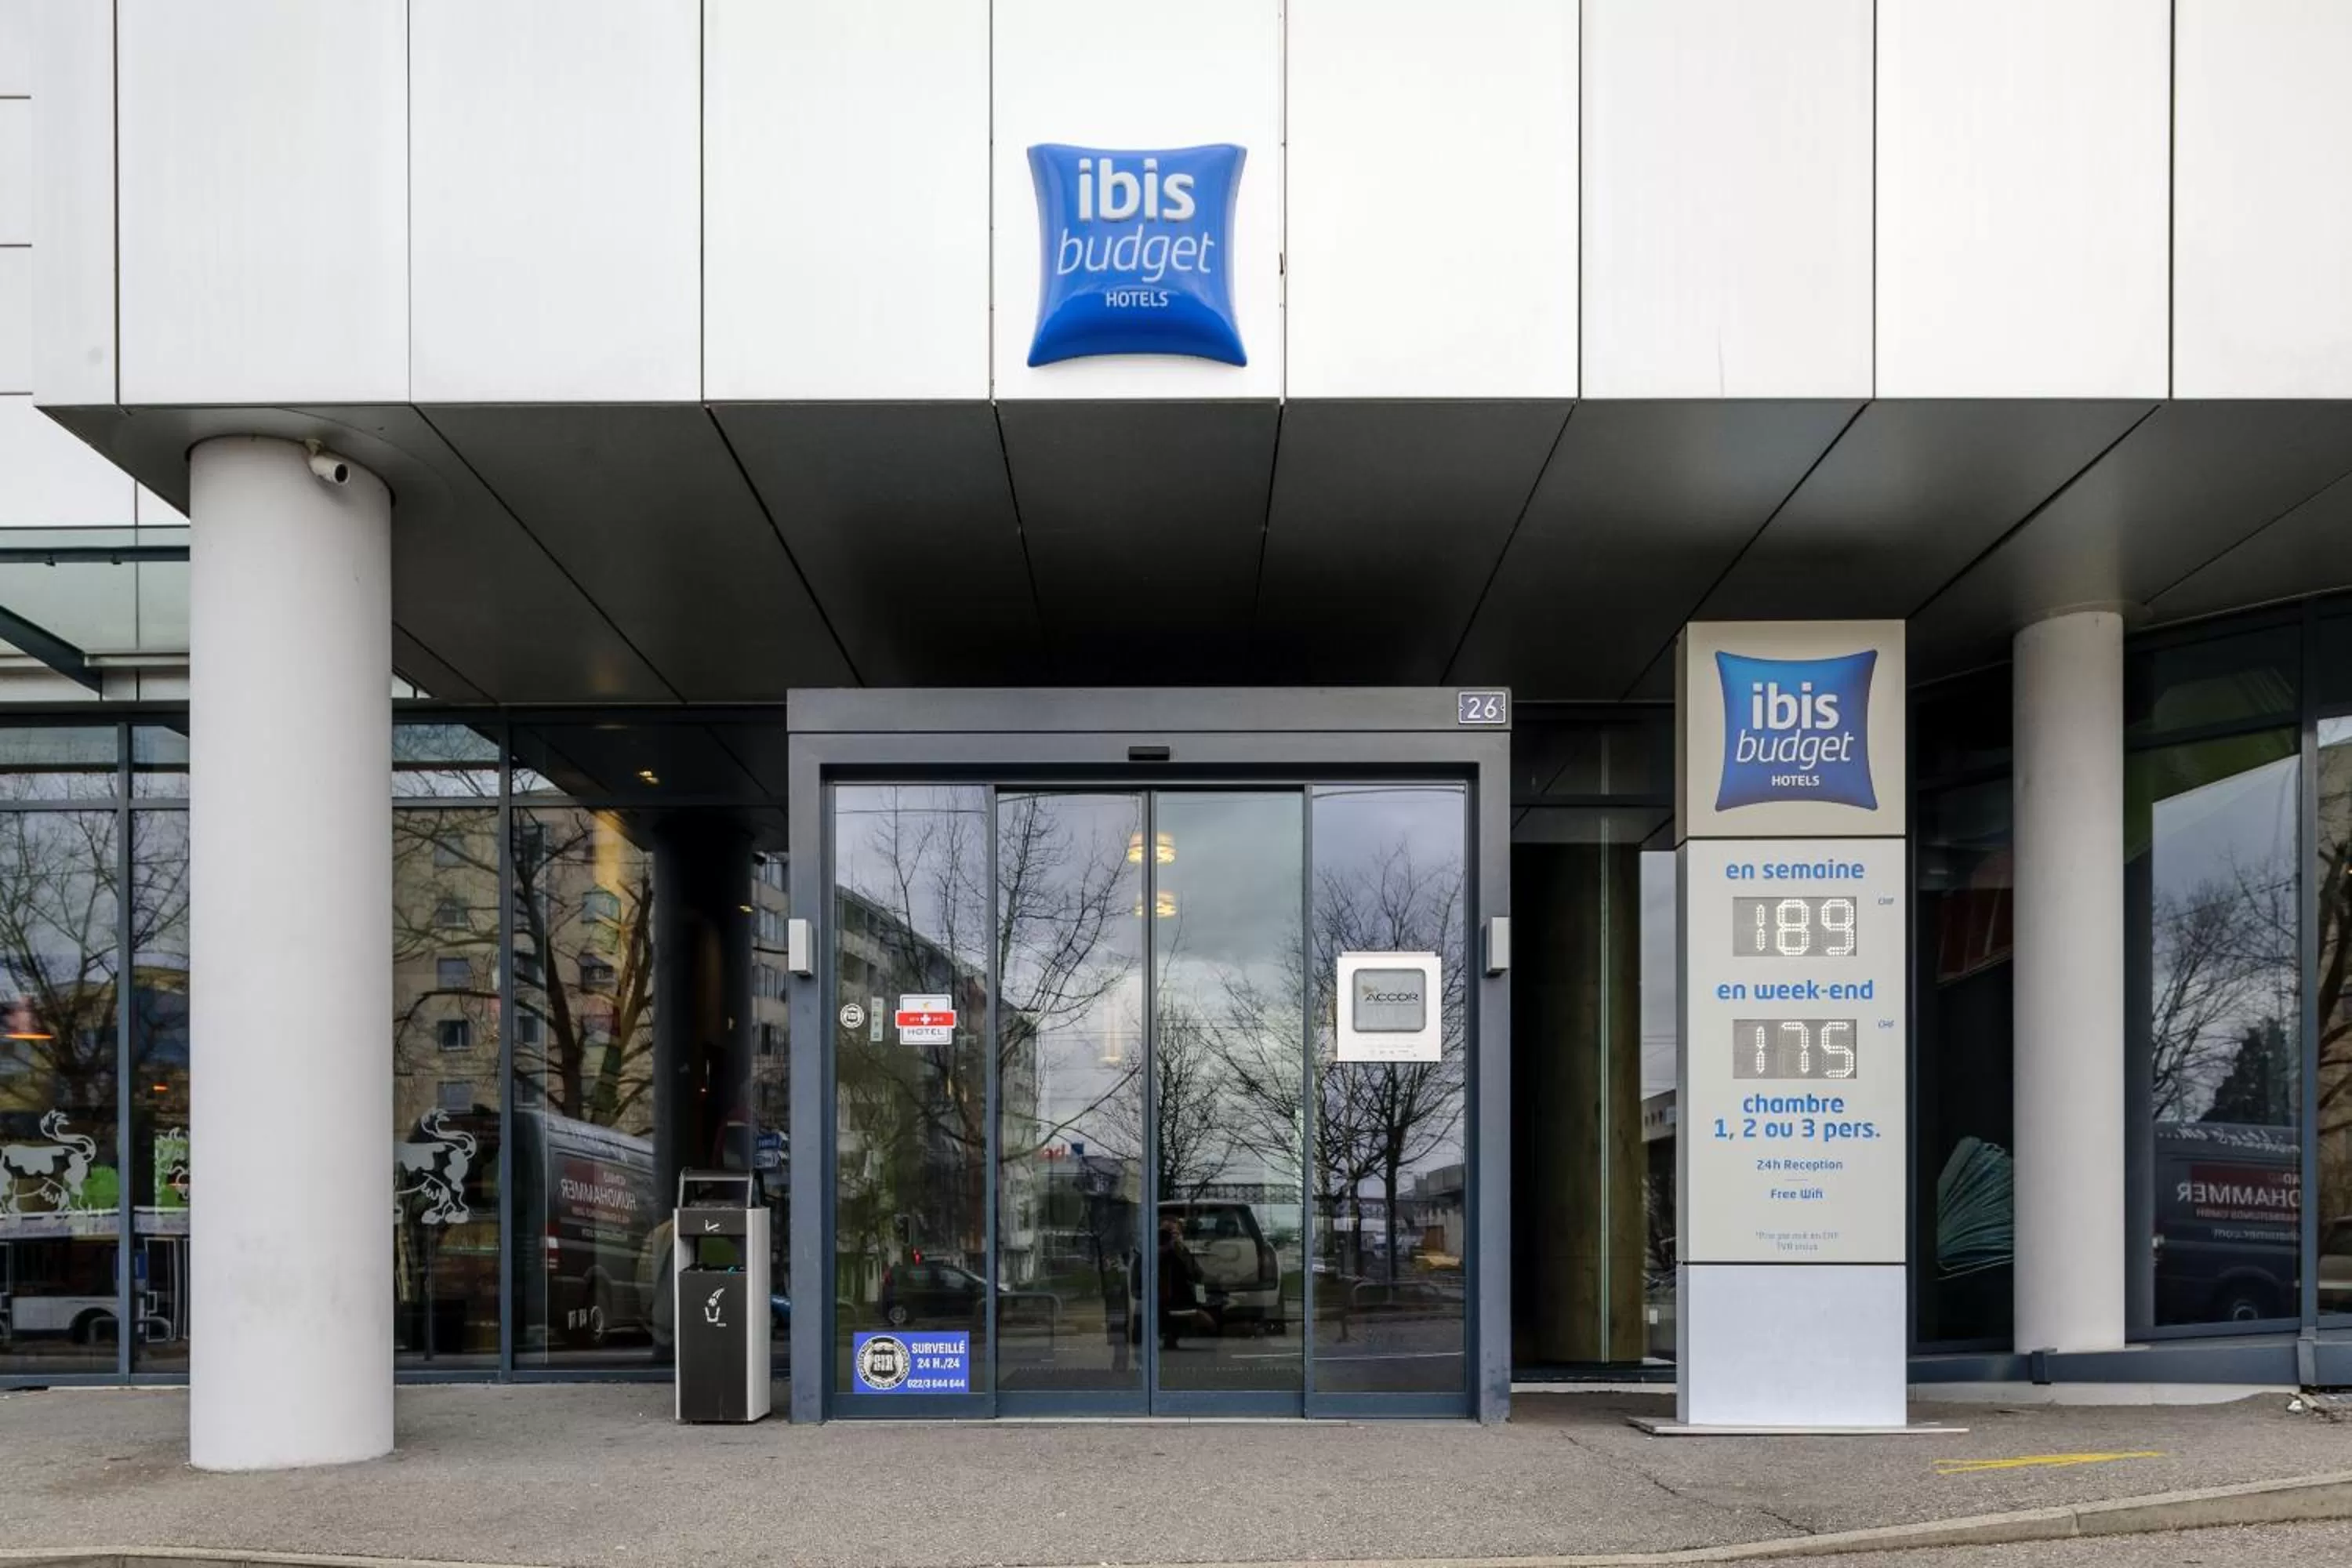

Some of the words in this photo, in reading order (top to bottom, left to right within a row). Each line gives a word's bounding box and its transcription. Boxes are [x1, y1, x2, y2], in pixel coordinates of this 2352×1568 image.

[1078, 158, 1196, 222] ibis
[1056, 223, 1214, 282] budget
[1106, 291, 1169, 307] HOTELS
[1467, 697, 1497, 719] 26
[1752, 682, 1840, 730] ibis
[1736, 729, 1854, 770] budget
[1771, 775, 1820, 786] HOTELS
[1726, 863, 1755, 880] en
[1762, 859, 1865, 880] semaine
[1755, 898, 1855, 956] 189
[1365, 993, 1418, 1002] ACCOR
[1717, 983, 1746, 1000] en
[1754, 980, 1874, 1000] week-end
[1755, 1021, 1855, 1078] 175
[1742, 1094, 1845, 1113] chambre
[1714, 1119, 1734, 1140] 1,
[1743, 1119, 1757, 1138] 2
[1764, 1123, 1794, 1138] ou
[1801, 1119, 1815, 1138] 3
[1824, 1123, 1881, 1142] pers.
[1756, 1160, 1780, 1171] 24h
[1784, 1160, 1843, 1172] Reception
[1769, 1189, 1797, 1200] Free
[1800, 1189, 1824, 1200] Wifi
[912, 1340, 965, 1354] SURVEILLÉ
[916, 1358, 930, 1369] 24
